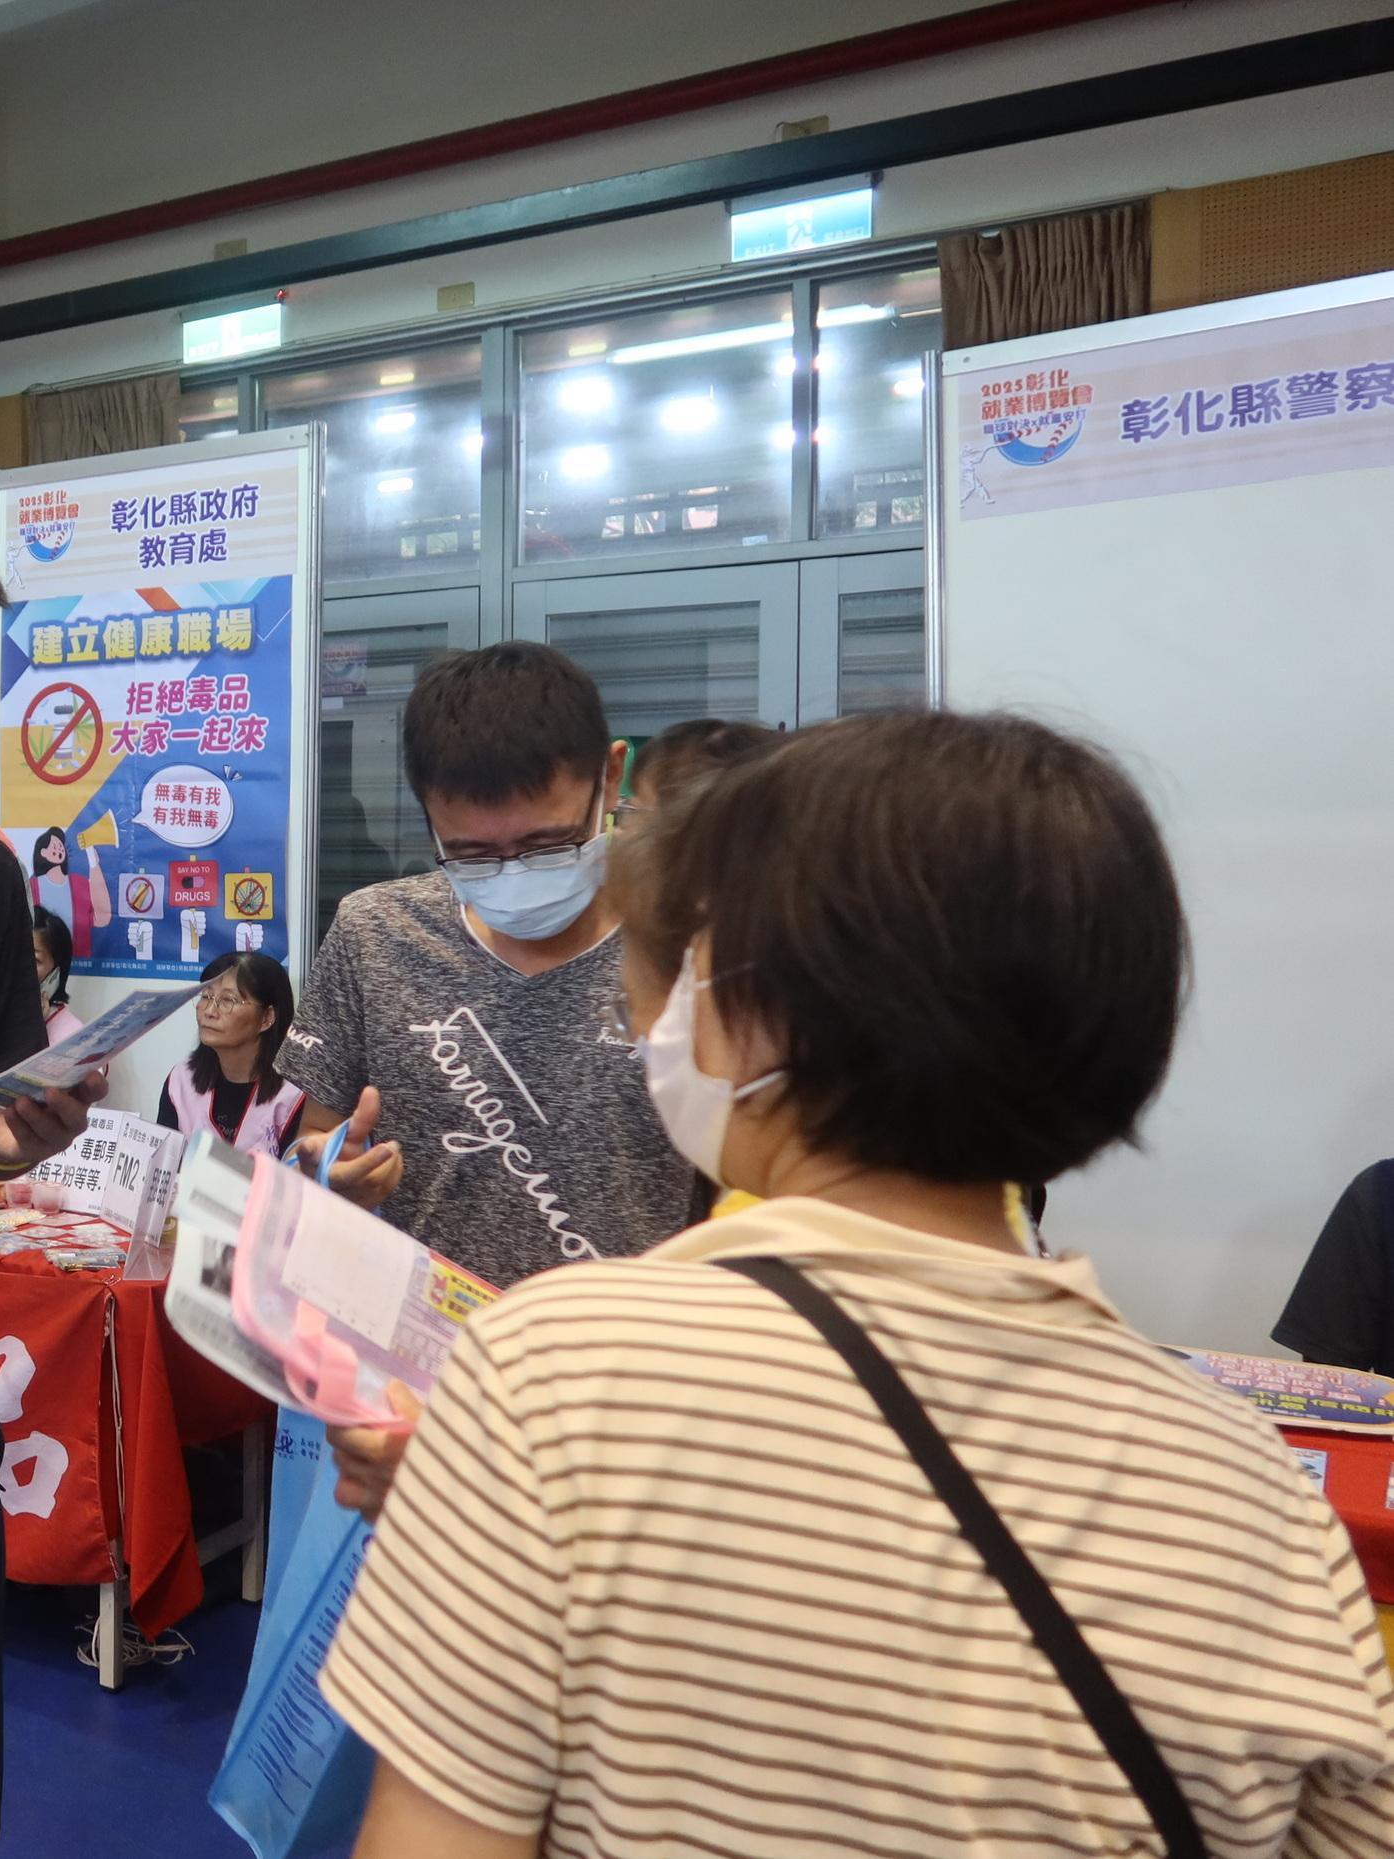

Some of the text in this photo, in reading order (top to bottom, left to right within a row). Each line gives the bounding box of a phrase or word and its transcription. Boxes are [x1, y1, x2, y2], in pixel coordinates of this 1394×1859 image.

[981, 369, 1069, 397] 2025彰化
[981, 384, 1093, 420] 就業博覽會
[1121, 362, 1394, 443] 彰化縣警察
[111, 484, 259, 533] 彰化縣政府
[139, 529, 227, 568] 教育處
[32, 607, 253, 664] 建立健康職場
[126, 675, 249, 716] 拒絕毒品
[110, 716, 268, 754] 大家一起來
[155, 783, 221, 806] 無毒有我
[152, 806, 219, 829] 有我無毒
[177, 866, 189, 874] SAY
[175, 891, 211, 901] DRUGS
